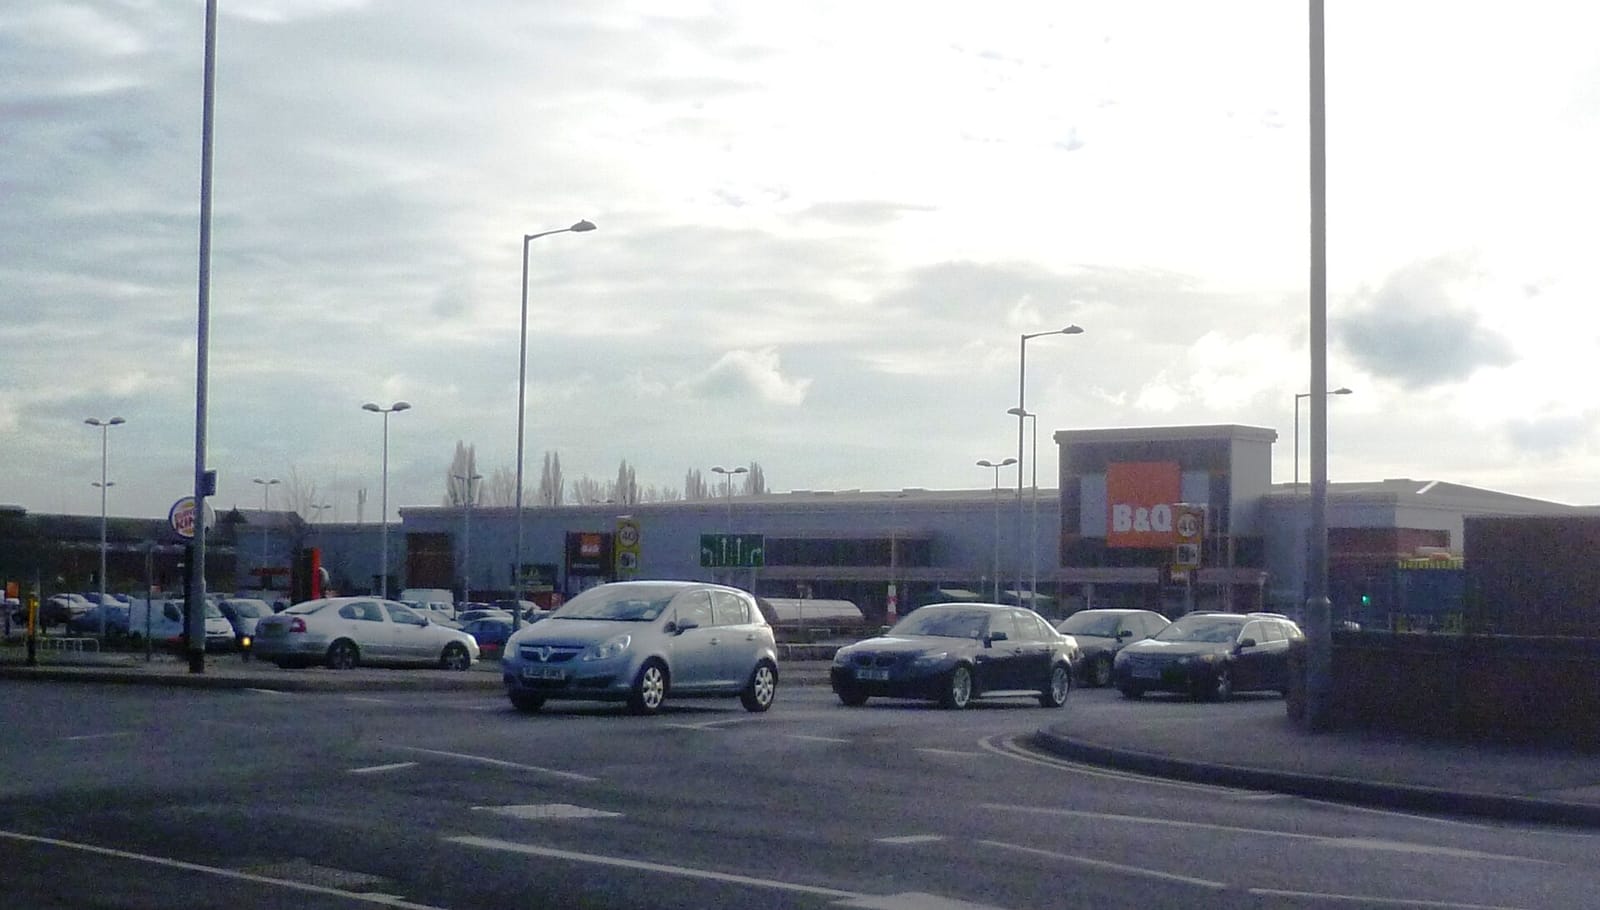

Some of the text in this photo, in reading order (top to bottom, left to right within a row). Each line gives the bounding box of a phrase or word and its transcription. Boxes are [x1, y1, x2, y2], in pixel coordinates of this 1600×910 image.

[1112, 504, 1173, 533] B&Q
[1179, 518, 1197, 532] 40
[621, 529, 636, 541] 40
